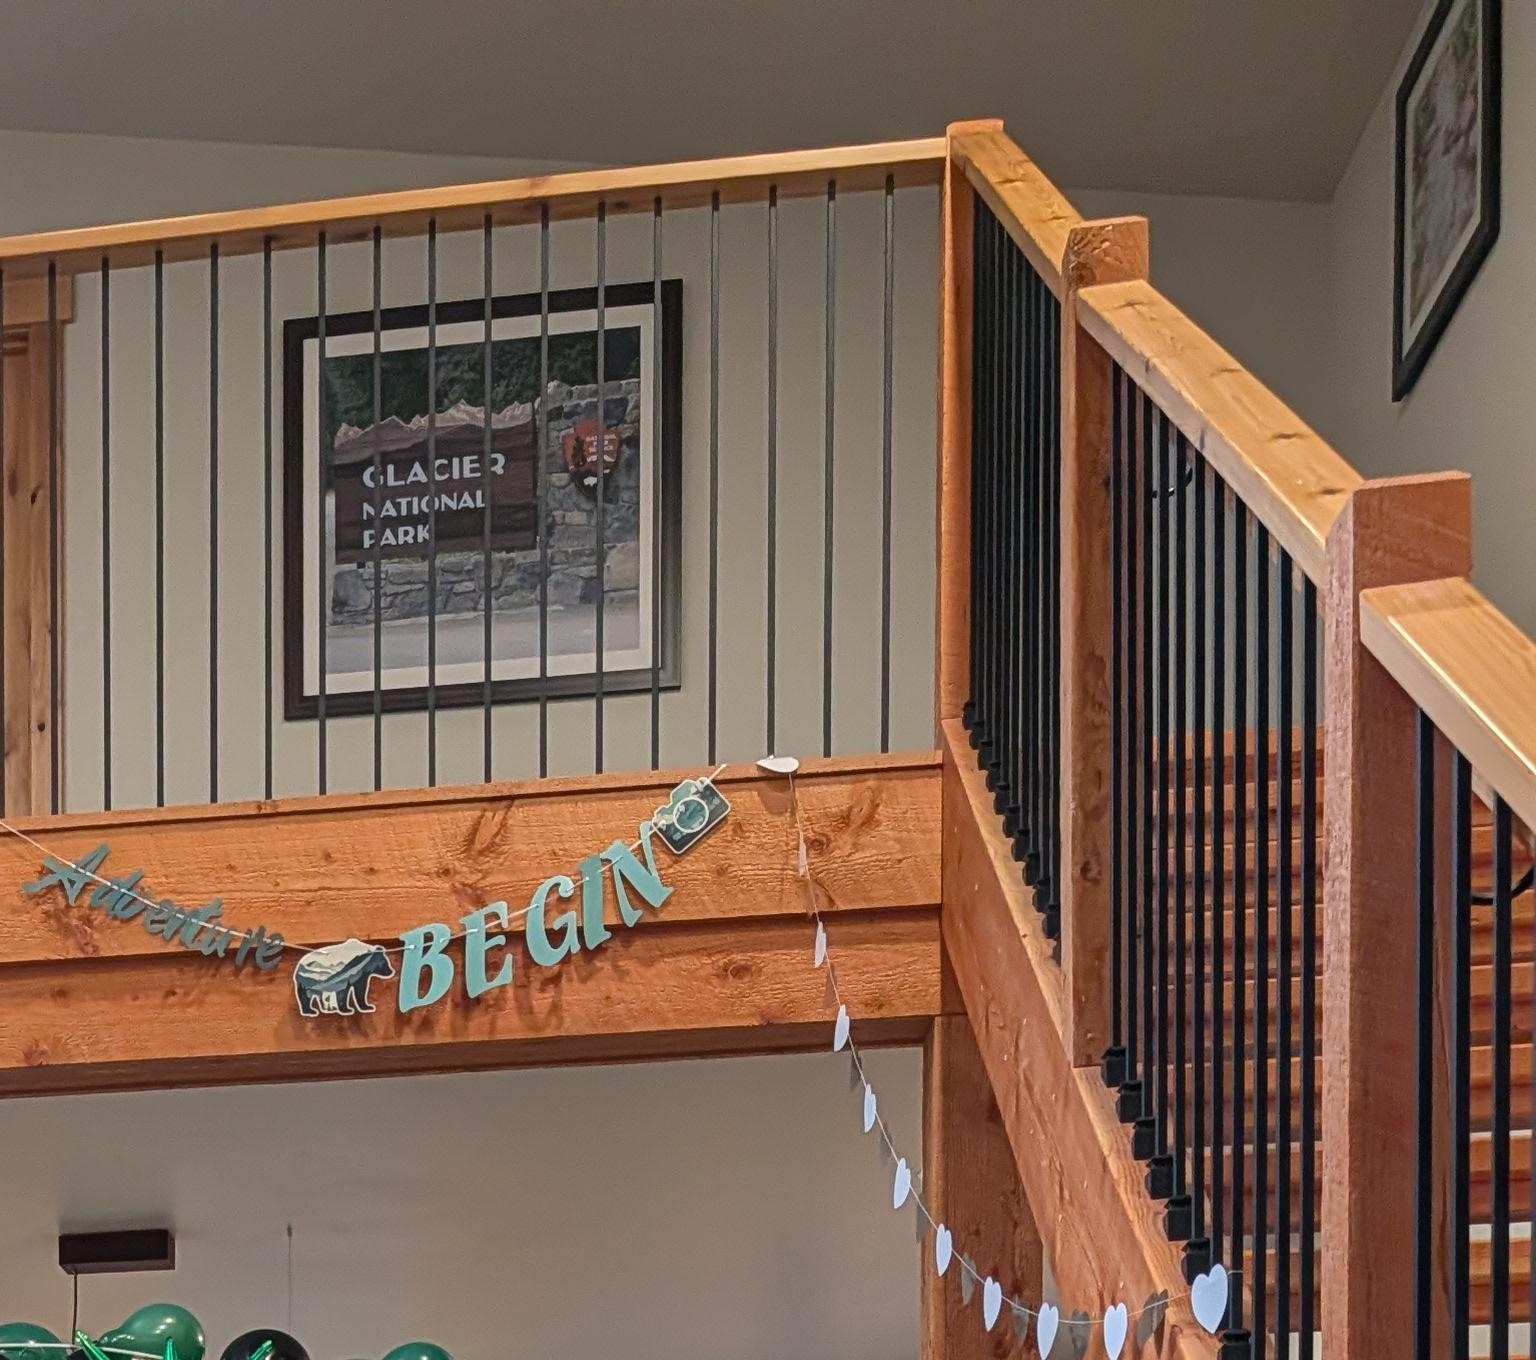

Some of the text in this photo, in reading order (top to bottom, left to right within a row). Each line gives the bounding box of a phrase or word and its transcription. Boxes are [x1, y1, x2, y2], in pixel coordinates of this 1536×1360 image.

[362, 453, 506, 488] GLACIER
[363, 490, 486, 520] NATIONAL
[363, 523, 431, 549] PARK
[21, 820, 674, 1013] Adventure BEGIN
